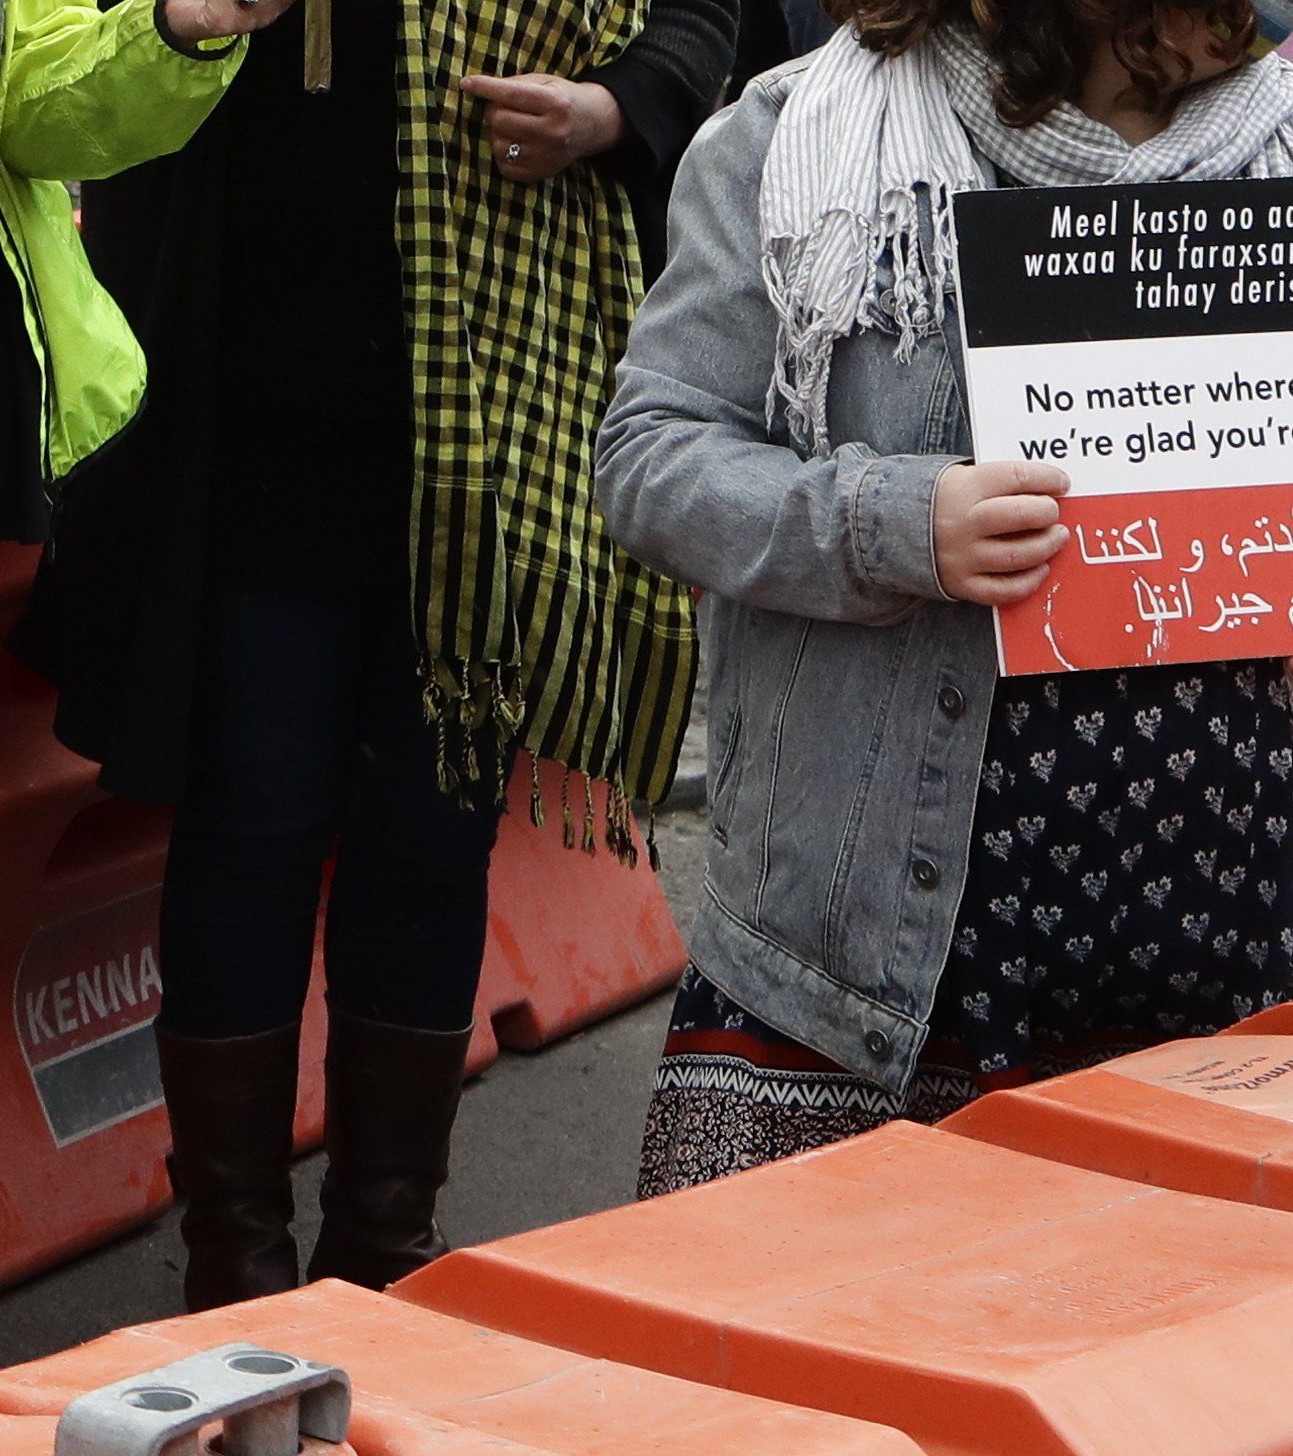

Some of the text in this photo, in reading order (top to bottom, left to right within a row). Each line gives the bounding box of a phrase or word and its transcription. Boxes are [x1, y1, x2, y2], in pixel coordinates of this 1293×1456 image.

[1050, 200, 1118, 239] Meel
[1132, 199, 1208, 235] kasto
[1222, 207, 1254, 230] oo
[1024, 250, 1116, 277] waxaa
[1130, 237, 1163, 272] ku
[1135, 272, 1217, 314] tahay
[1025, 383, 1074, 414] No
[1086, 380, 1195, 410] matter
[1019, 416, 1293, 463] we're glad you'r
[1074, 515, 1164, 565] لكننا
